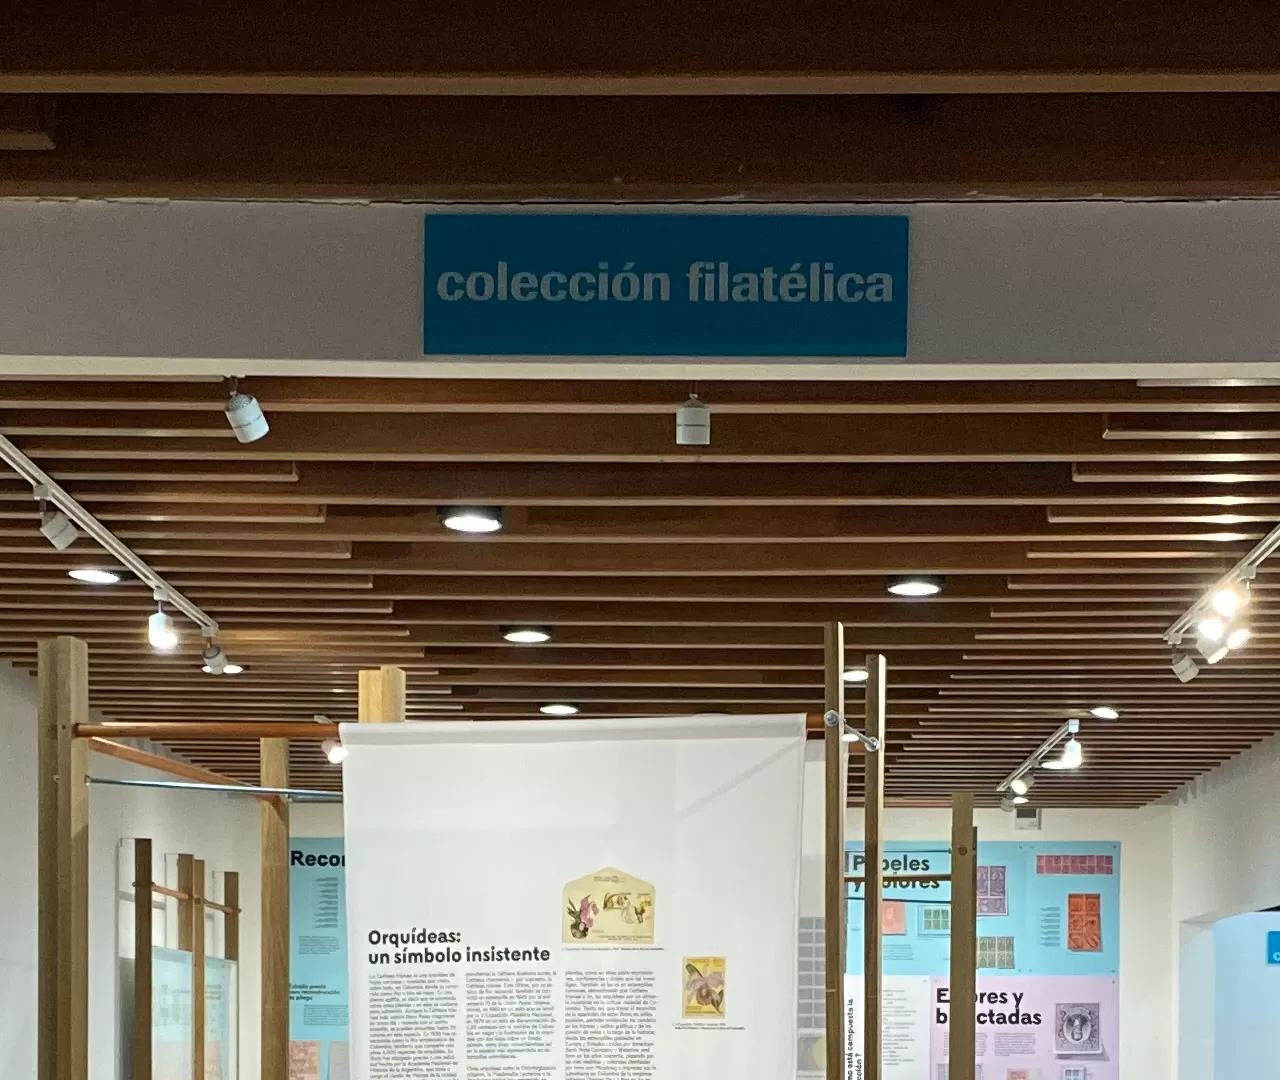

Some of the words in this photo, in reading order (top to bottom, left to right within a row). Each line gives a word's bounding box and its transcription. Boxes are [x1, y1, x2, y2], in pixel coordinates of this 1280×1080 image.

[436, 260, 671, 302] colección
[685, 260, 894, 303] filatélica
[368, 926, 461, 948] Orquídeas:
[368, 952, 390, 965] un
[393, 946, 462, 965] símbolo
[465, 945, 551, 963] insistente
[936, 988, 1008, 1004] Eres
[1012, 992, 1024, 1008] y
[936, 1008, 1042, 1025] bctadas
